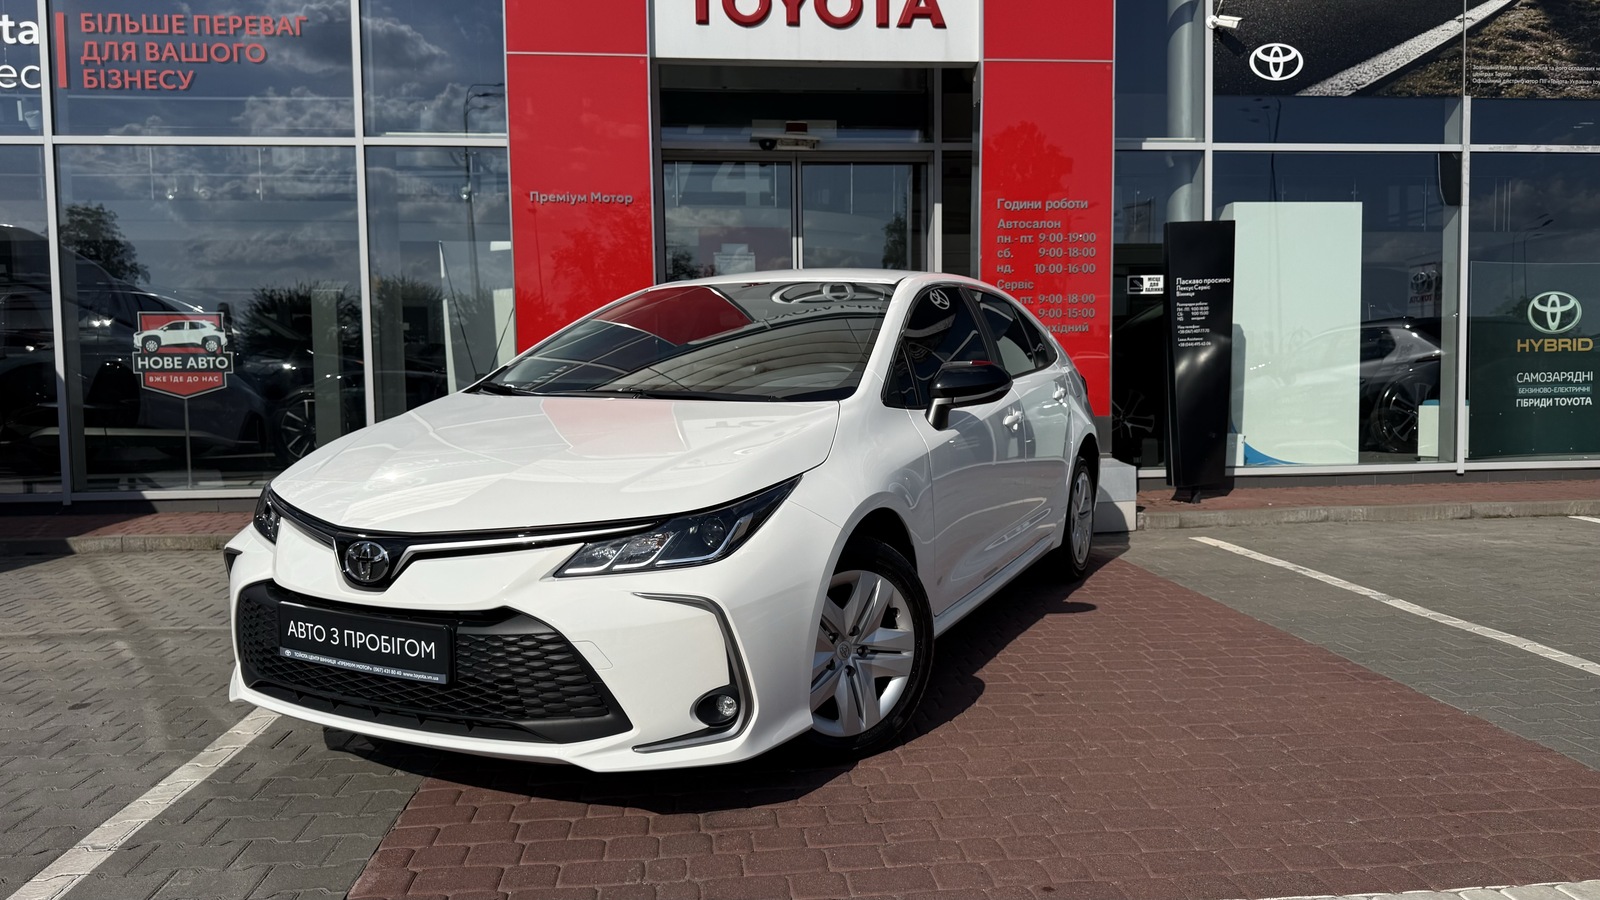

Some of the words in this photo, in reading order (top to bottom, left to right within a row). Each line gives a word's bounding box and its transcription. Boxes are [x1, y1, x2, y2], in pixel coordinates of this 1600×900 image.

[80, 12, 185, 35] БІЛЬШЕ
[193, 15, 308, 36] ПЕРЕВАГ
[80, 41, 137, 65] ДЛЯ
[145, 42, 266, 63] ВАШОГО
[83, 69, 194, 90] БІЗНЕСУ
[530, 191, 587, 205] Преміум
[590, 192, 633, 205] Мотор
[997, 198, 1042, 210] Години
[1045, 198, 1088, 211] роботи
[997, 219, 1061, 229] Автосалон
[1038, 233, 1096, 243] 9:00-19:00
[997, 248, 1014, 258] сб.
[1038, 247, 1096, 257] 9:00-18:00
[997, 265, 1014, 274] нд.
[1034, 264, 1096, 274] 10:00-16:00
[997, 279, 1034, 291] Сервіс
[1176, 277, 1203, 285] Ласкаво
[1038, 294, 1096, 303] 9:00-18:00
[1038, 308, 1096, 318] 9:00-15:00
[1516, 338, 1594, 353] HYBRID
[137, 357, 182, 369] НОВЕ
[186, 357, 229, 369] АВТО
[170, 375, 184, 383] ЇДЕ
[1516, 371, 1593, 383] САМОЗАРЯДНІ
[1518, 386, 1590, 394] БЕНЗИНОВО-ЕЛЕКТРИЧНІ
[1516, 398, 1553, 408] ГІБРИДИ
[1554, 397, 1592, 406] TOYOTA
[287, 620, 326, 642] АВТО
[344, 630, 436, 660] ПРОБІГОМ
